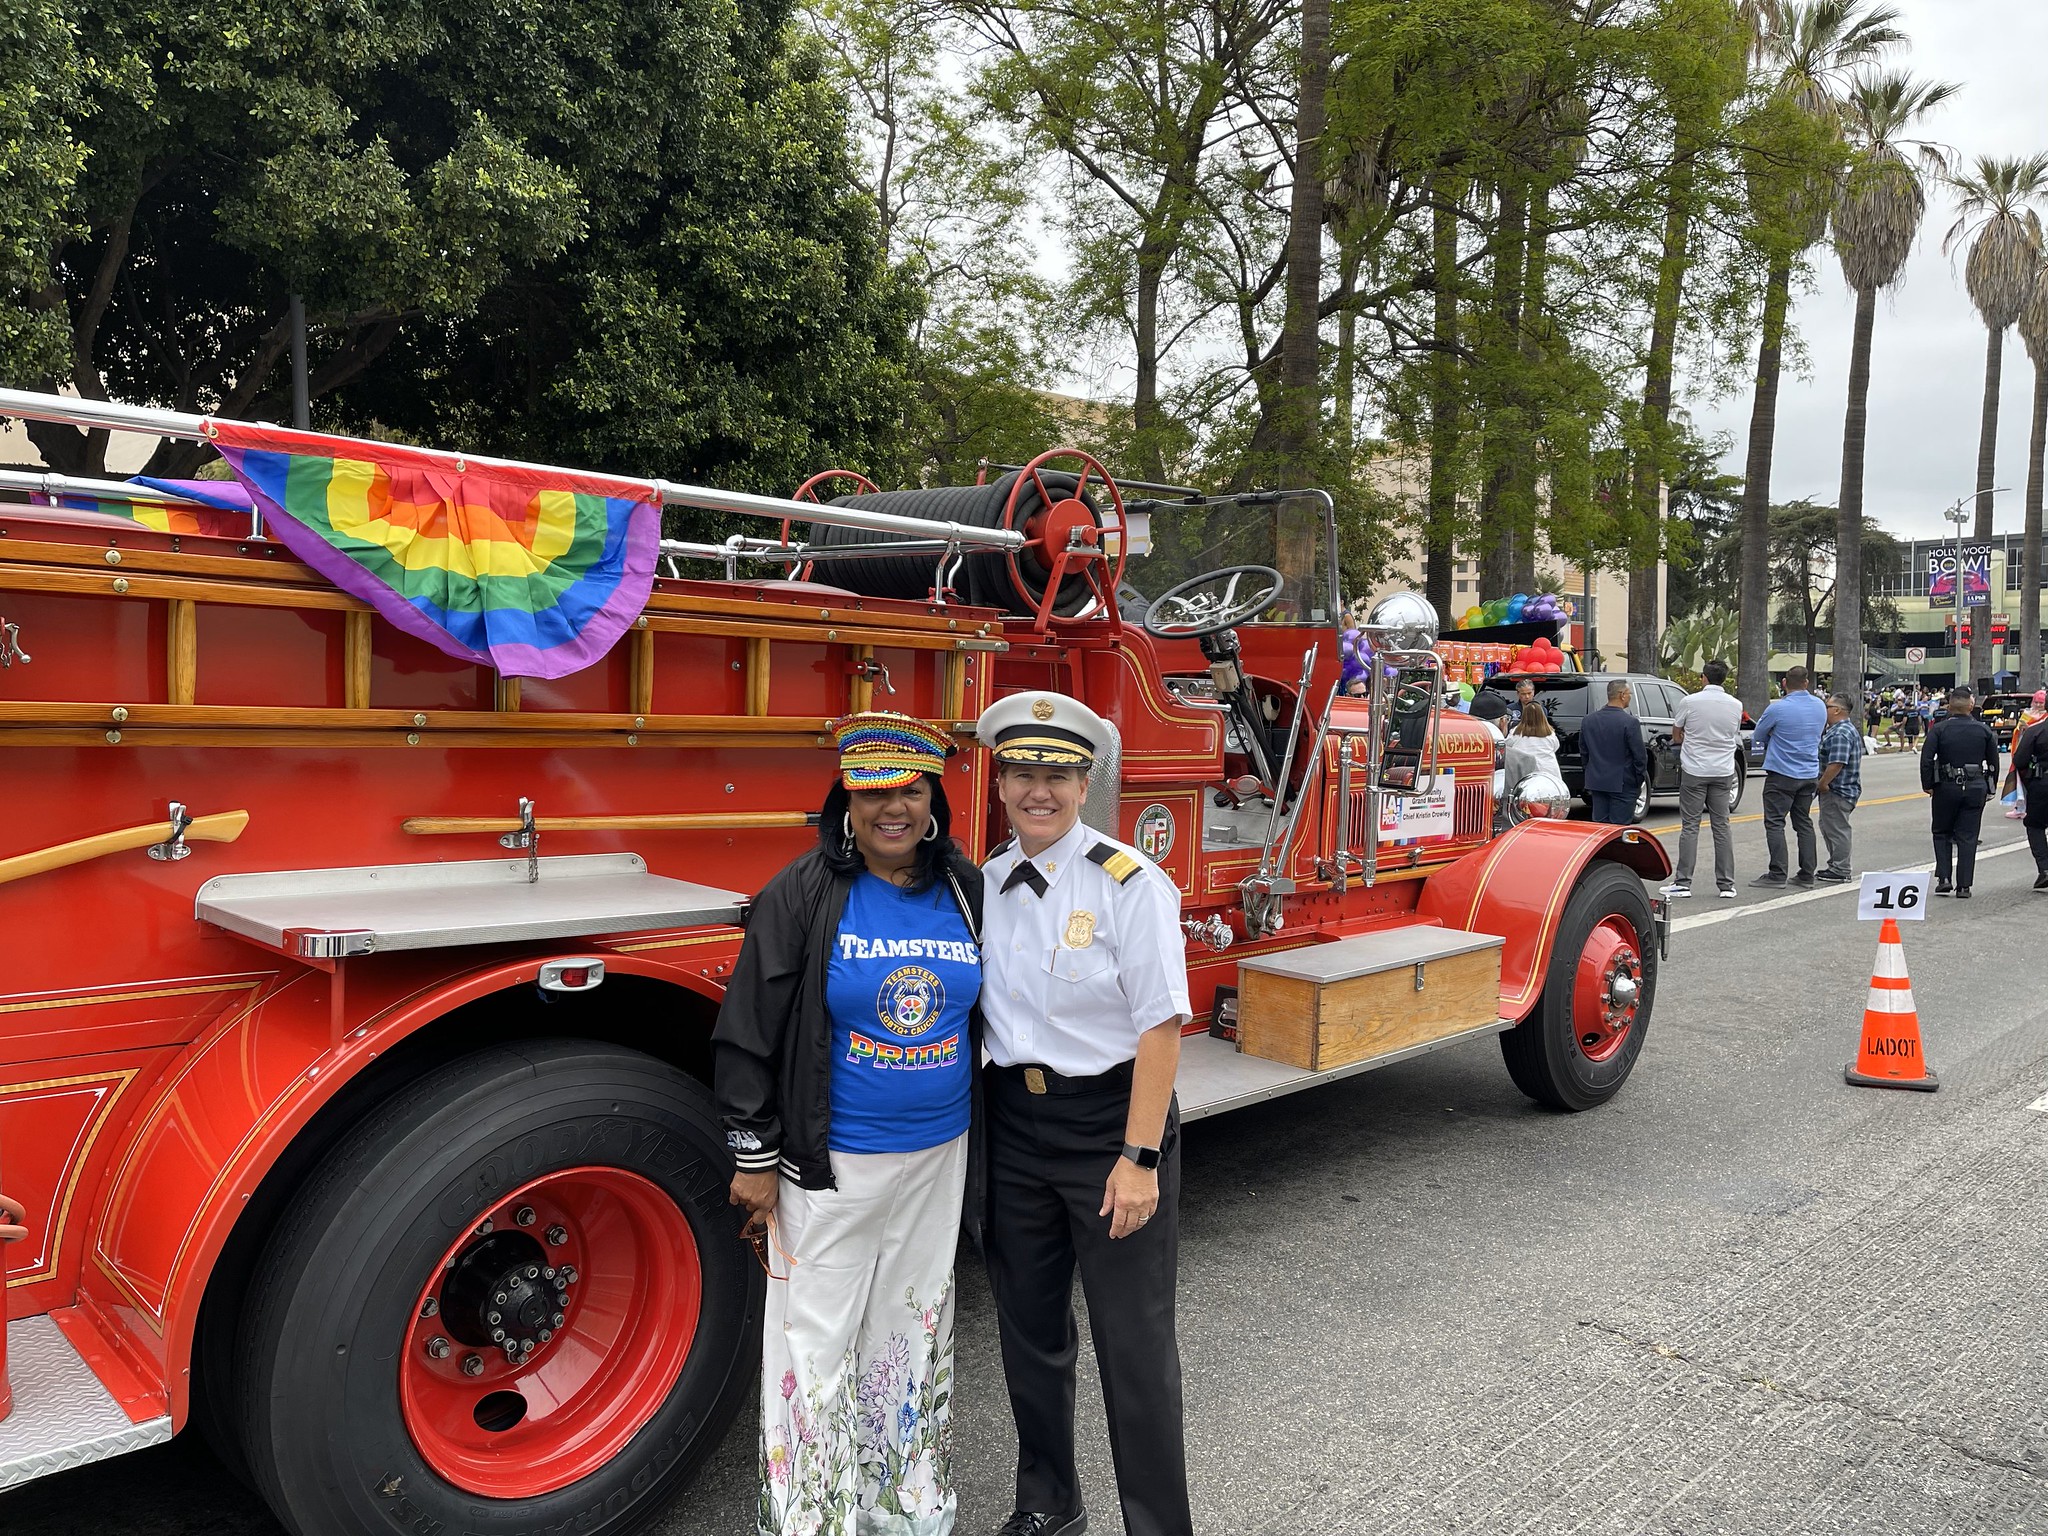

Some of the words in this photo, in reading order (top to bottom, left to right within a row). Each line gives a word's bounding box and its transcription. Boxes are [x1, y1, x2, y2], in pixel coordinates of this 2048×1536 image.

[1929, 555, 1990, 574] BOWL
[1427, 732, 1485, 755] ANGELES
[1428, 795, 1446, 803] Marshal
[1403, 812, 1415, 820] Chief
[1416, 811, 1431, 819] Kristin
[1432, 810, 1451, 818] Crowley
[1873, 885, 1919, 910] 16
[839, 933, 980, 965] TEAMSTERS
[886, 967, 940, 987] TEAMSTERS
[880, 1010, 909, 1035] LGBTQ+
[910, 1010, 939, 1035] CAUCUS
[846, 1030, 960, 1071] PRIDE
[1867, 1037, 1916, 1059] LADOT
